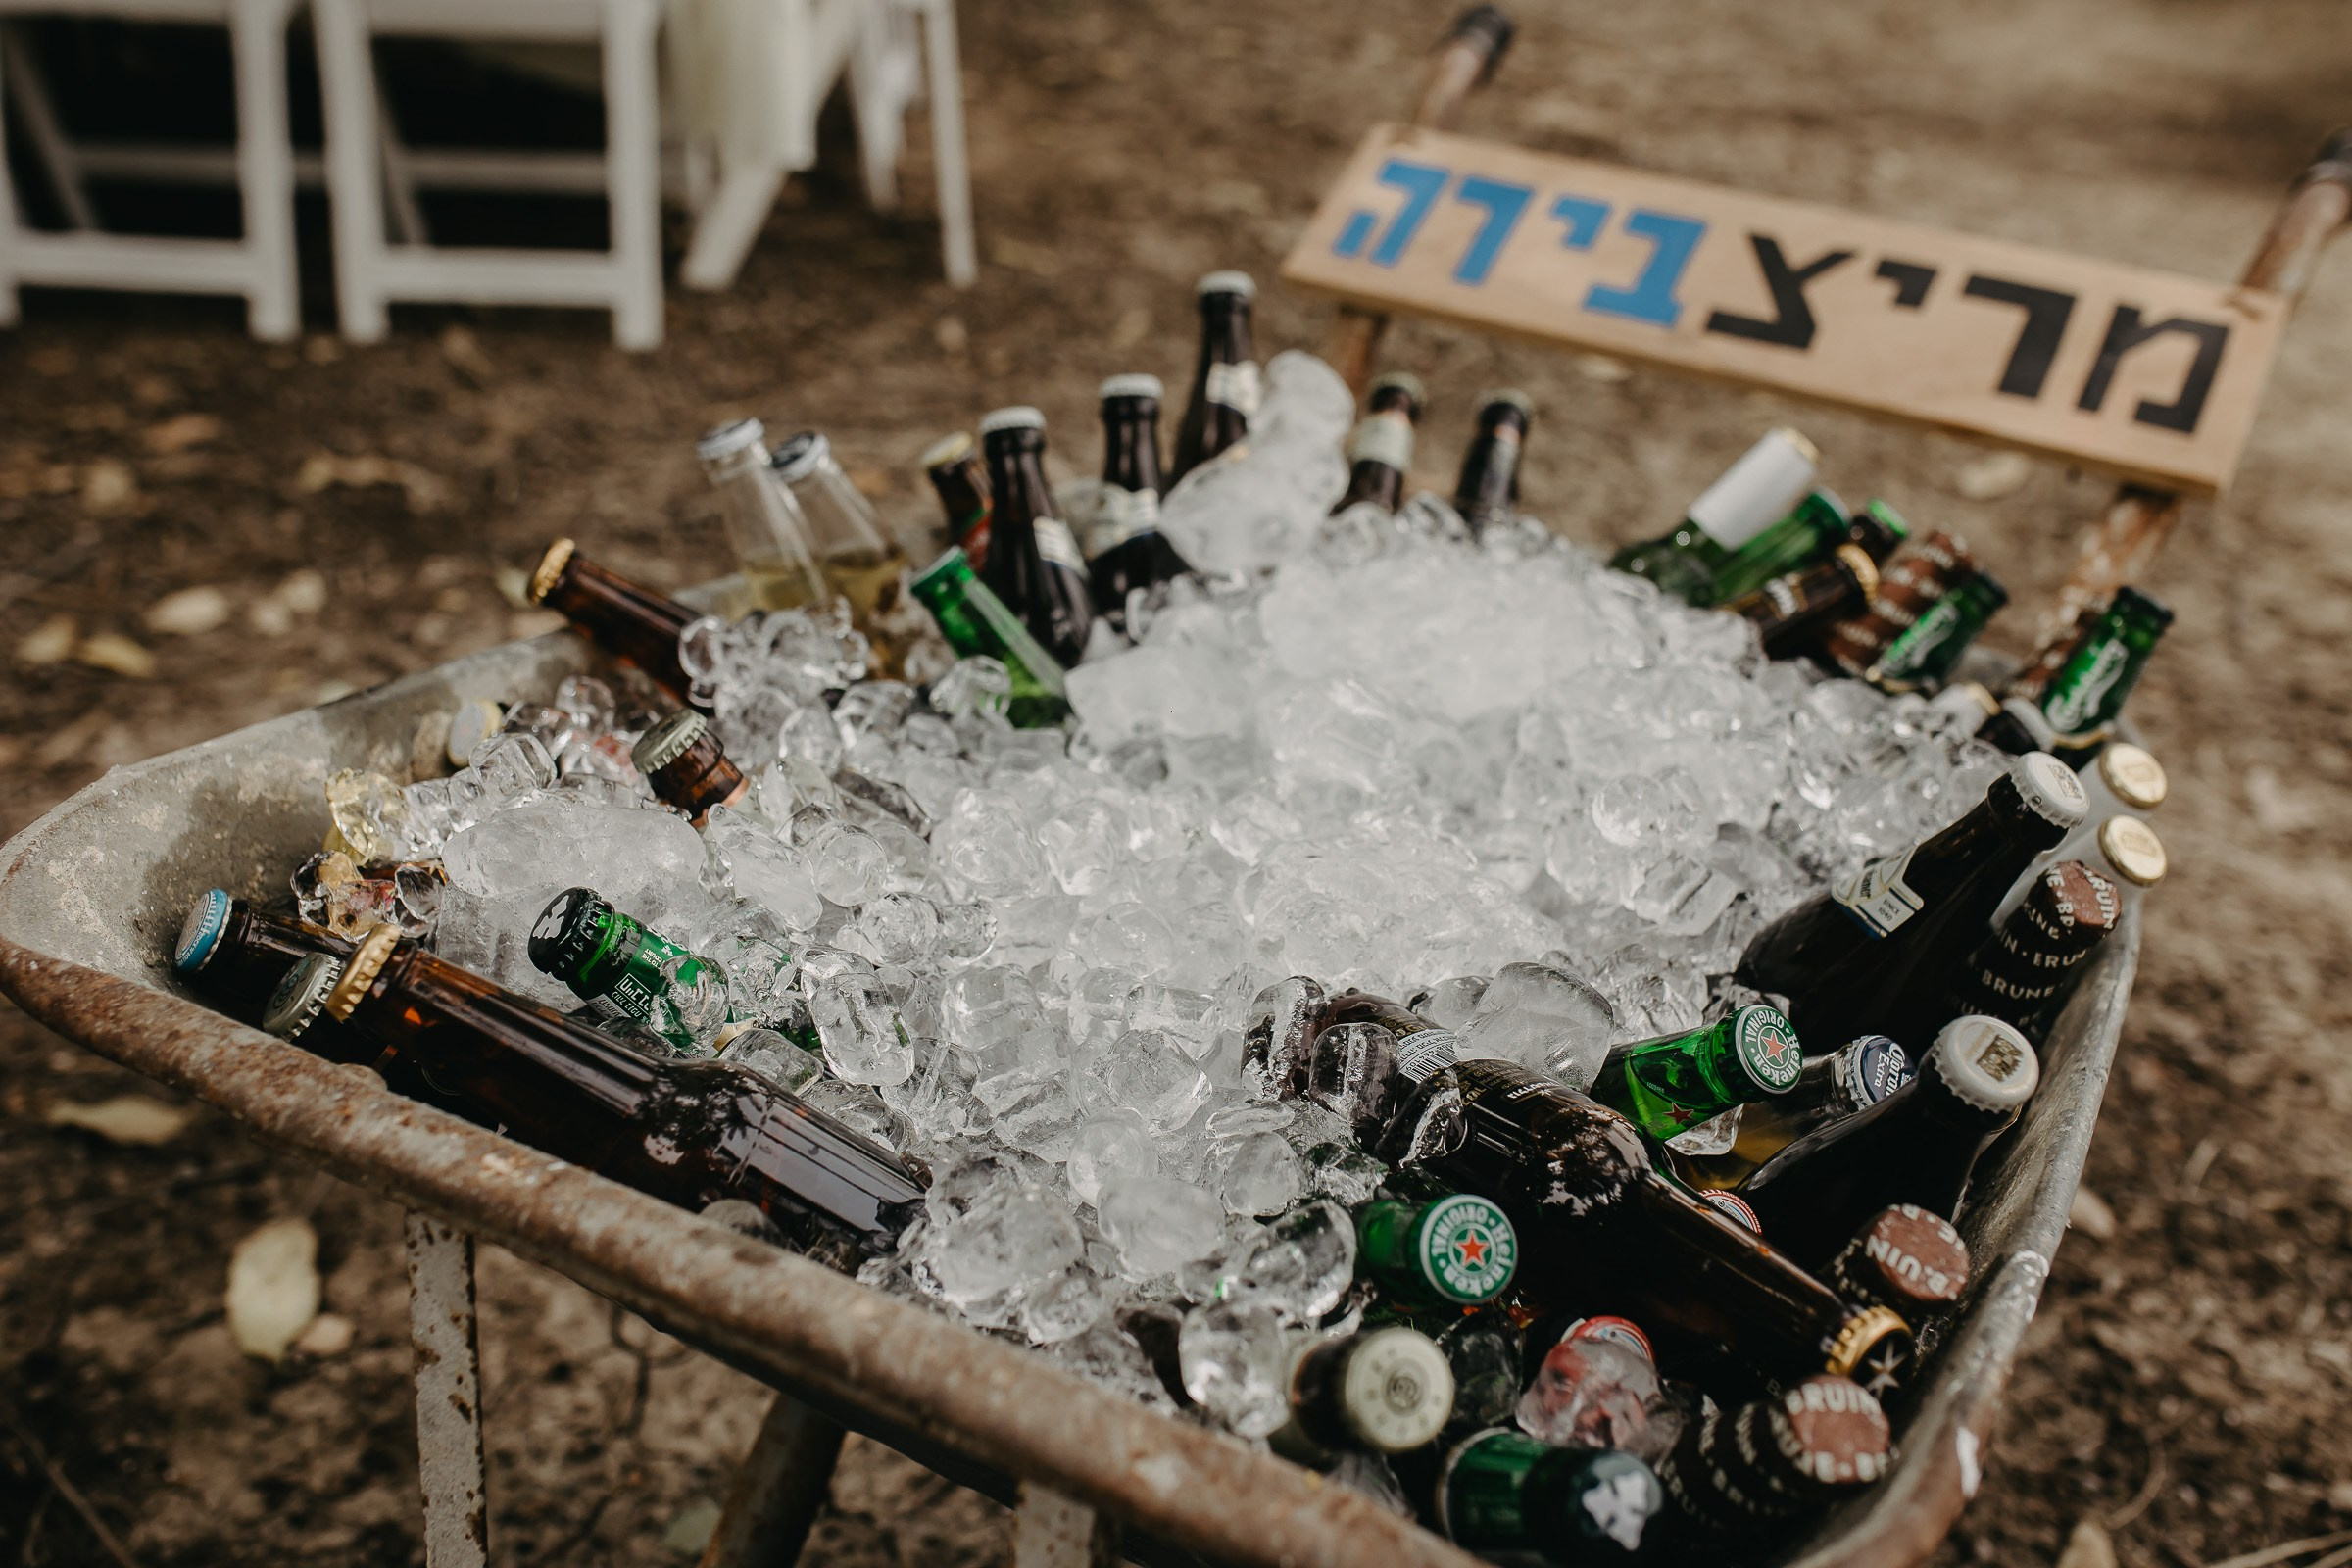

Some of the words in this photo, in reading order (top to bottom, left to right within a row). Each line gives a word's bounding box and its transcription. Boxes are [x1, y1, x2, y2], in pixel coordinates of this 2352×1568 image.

[618, 977, 644, 1002] חייב
[1744, 1009, 1786, 1044] ORIGINAL
[1752, 1033, 1803, 1086] Heineken
[1874, 1051, 1890, 1088] Extra
[1885, 1042, 1906, 1096] Coron
[1431, 1203, 1490, 1258] ORIGINAL
[1443, 1221, 1514, 1298] Heineken
